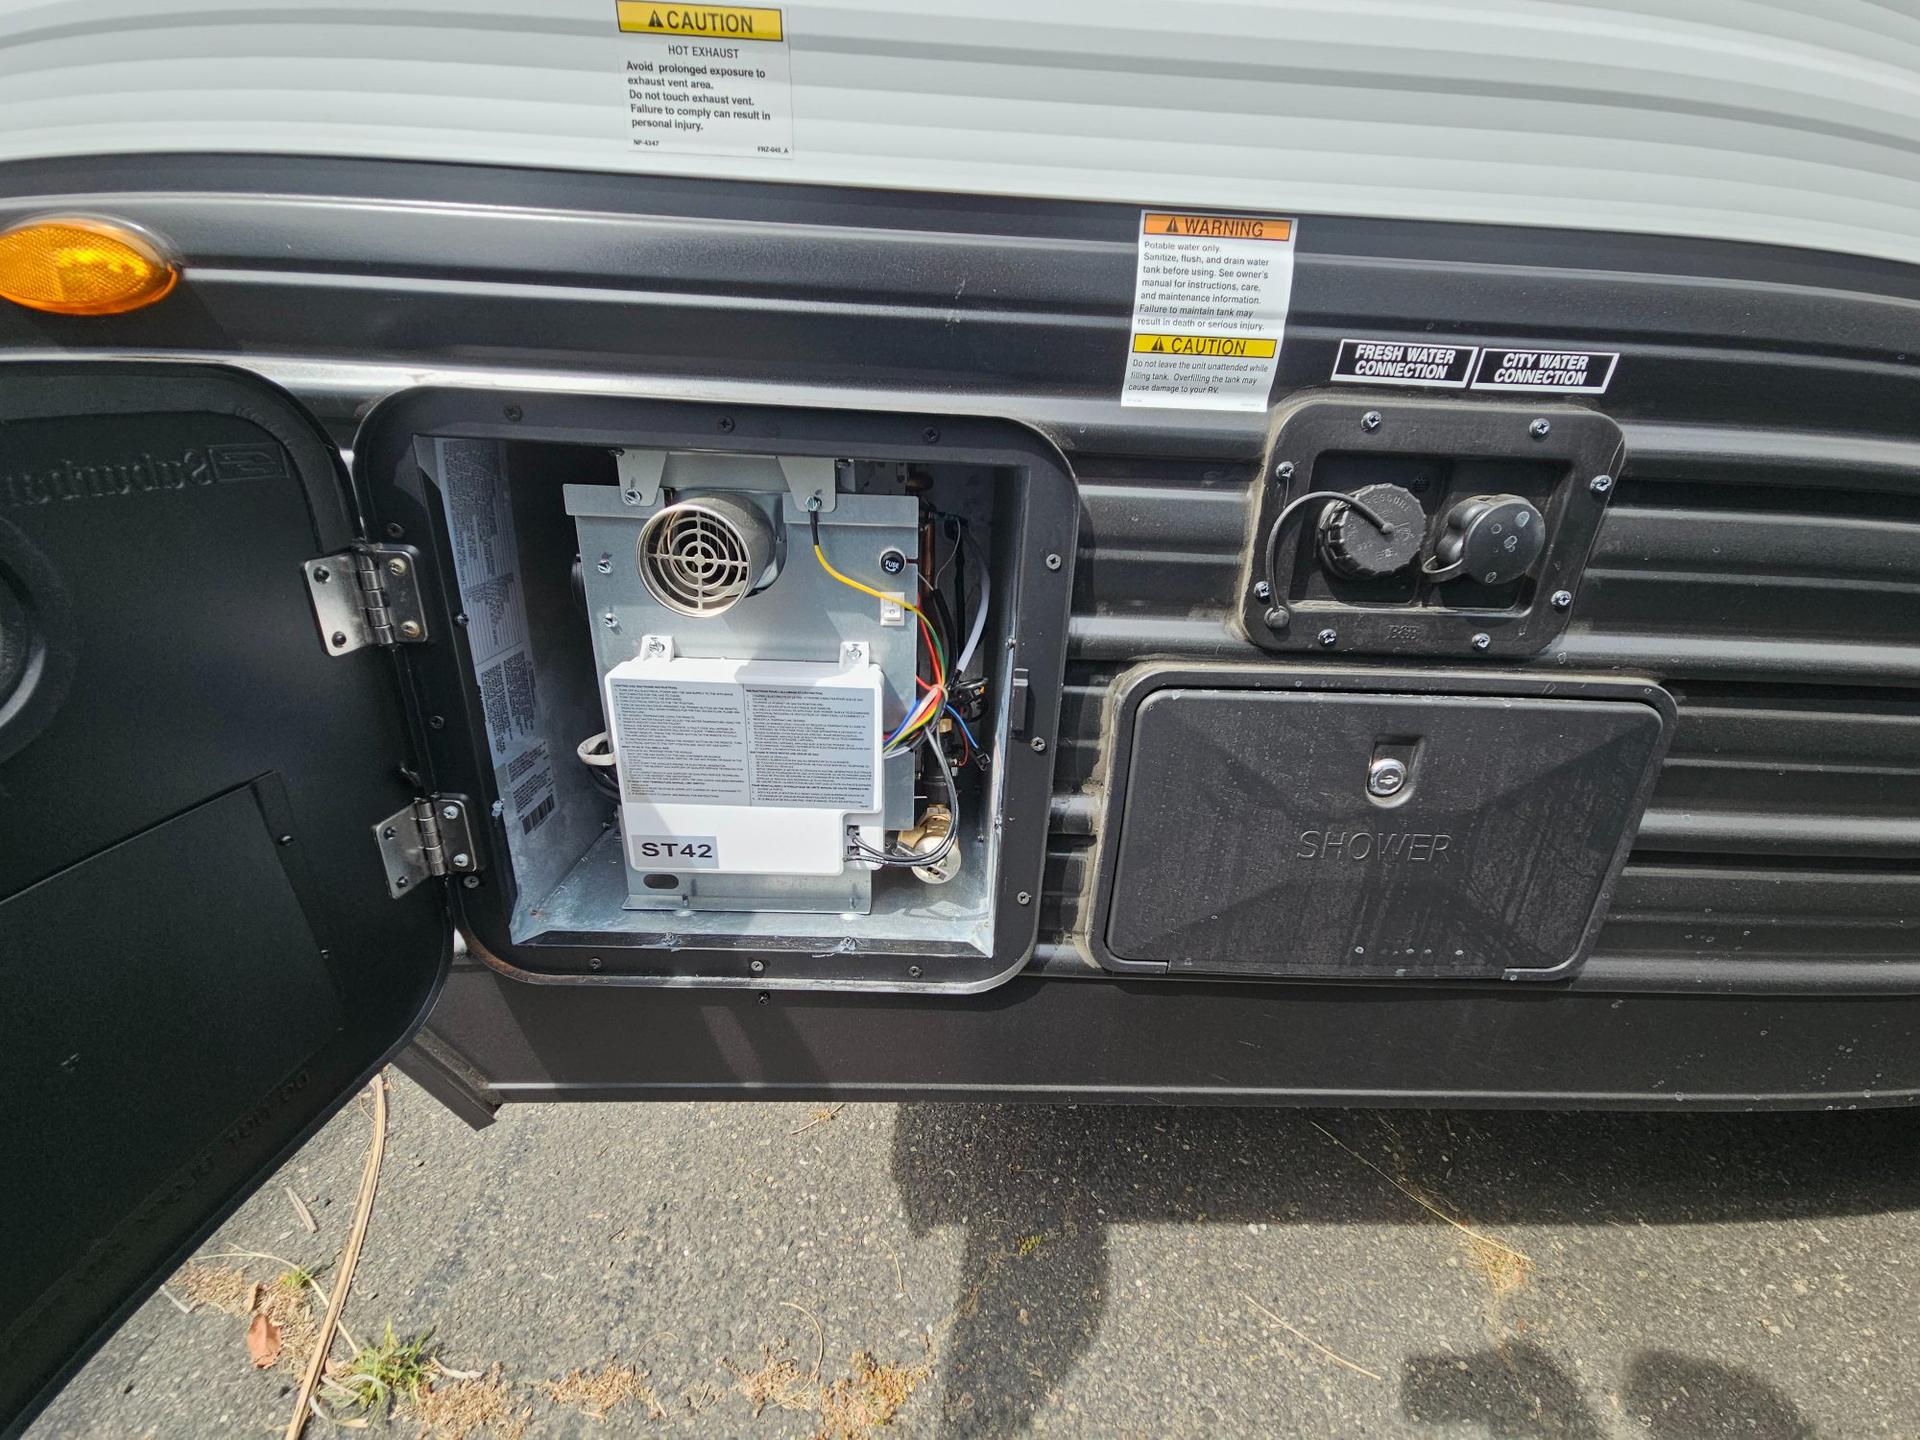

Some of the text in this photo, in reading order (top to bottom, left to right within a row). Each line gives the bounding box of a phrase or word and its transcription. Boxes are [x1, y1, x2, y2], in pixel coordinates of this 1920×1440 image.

[666, 10, 753, 33] CAUTION
[668, 45, 739, 58] HOT EXHAUST
[627, 61, 765, 78] Avoid prolonged exposure to
[628, 77, 714, 89] exhaust vent area.
[629, 90, 754, 105] Do not touch exhaust vent.
[631, 104, 770, 120] Failure to comply can result in
[632, 118, 703, 132] personal injury.
[1185, 218, 1263, 237] WARNING
[1144, 241, 1221, 253] Potable water only.
[1144, 253, 1179, 263] Sanitize,
[1181, 255, 1204, 264] flush,
[1206, 256, 1222, 264] and
[1224, 257, 1245, 265] drain
[1143, 266, 1268, 279] tank before using. See owner's
[1142, 279, 1172, 288] manual
[1174, 280, 1186, 288] for
[1188, 281, 1239, 291] instructions,
[1141, 292, 1261, 305] and maintenance information.
[1139, 305, 1167, 313] Failure
[1180, 307, 1214, 315] maintain
[1217, 308, 1234, 316] tank
[1236, 310, 1253, 318] may
[1138, 318, 1161, 326] result
[1172, 319, 1195, 327] death
[1208, 321, 1237, 329] serious
[1240, 321, 1264, 331] injury.
[1171, 338, 1247, 355] CAUTION
[1355, 344, 1456, 364] FRESH WATER
[1207, 362, 1248, 371] unattended
[1250, 364, 1268, 372] while
[1502, 352, 1589, 370] CITY WATER
[1355, 360, 1448, 379] CONNECTION
[1131, 372, 1150, 382] filling
[1152, 373, 1169, 381] tank.
[1174, 374, 1210, 384] Overfilling
[1242, 377, 1257, 385] may
[1494, 368, 1587, 385] CONNECTION
[1151, 385, 1179, 394] damage
[1190, 386, 1206, 395] your
[1207, 386, 1219, 394] RV.
[885, 560, 899, 569] FUSE
[641, 842, 713, 858] ST42
[1297, 830, 1453, 862] SHOWER
